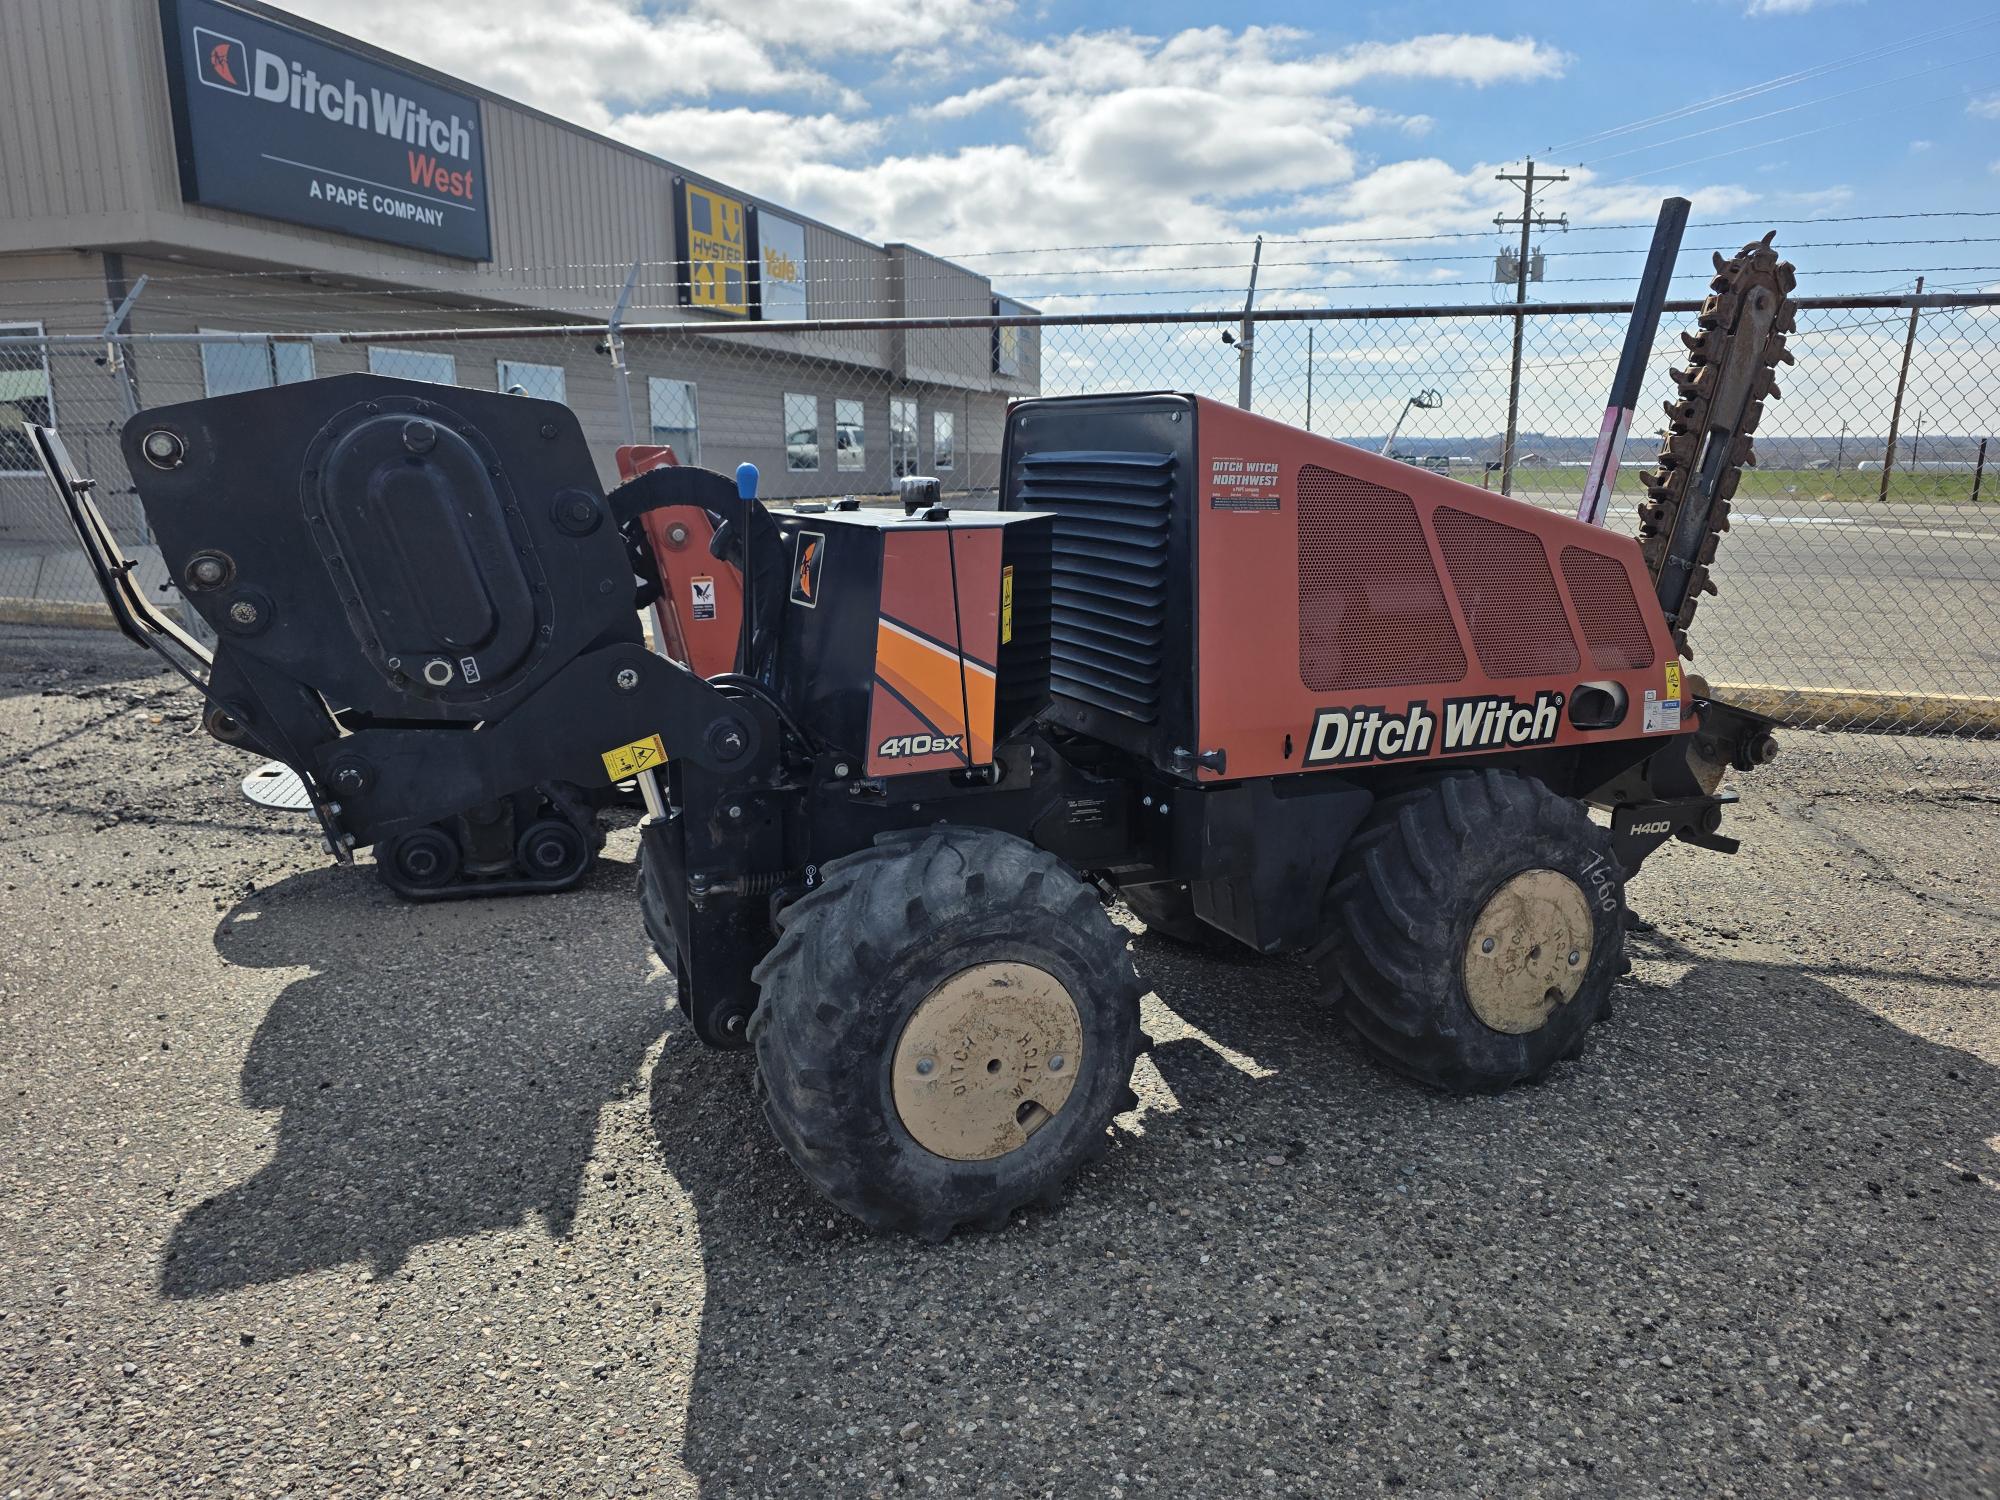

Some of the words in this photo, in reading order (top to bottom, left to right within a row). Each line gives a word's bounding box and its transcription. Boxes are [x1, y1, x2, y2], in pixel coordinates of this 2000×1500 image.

[407, 151, 474, 200] West
[309, 180, 323, 200] A
[326, 183, 369, 211] PAPÉ
[372, 197, 444, 228] COMPANY
[693, 236, 742, 265] HYSTER
[763, 244, 796, 284] Yale
[1213, 461, 1243, 471] DITCH
[1246, 463, 1278, 473] WITCH
[1213, 475, 1278, 486] NORTHWEST
[1308, 703, 1434, 762] Ditch
[1445, 695, 1558, 749] Witch
[1629, 820, 1671, 836] H400
[1579, 848, 1617, 912] 7660
